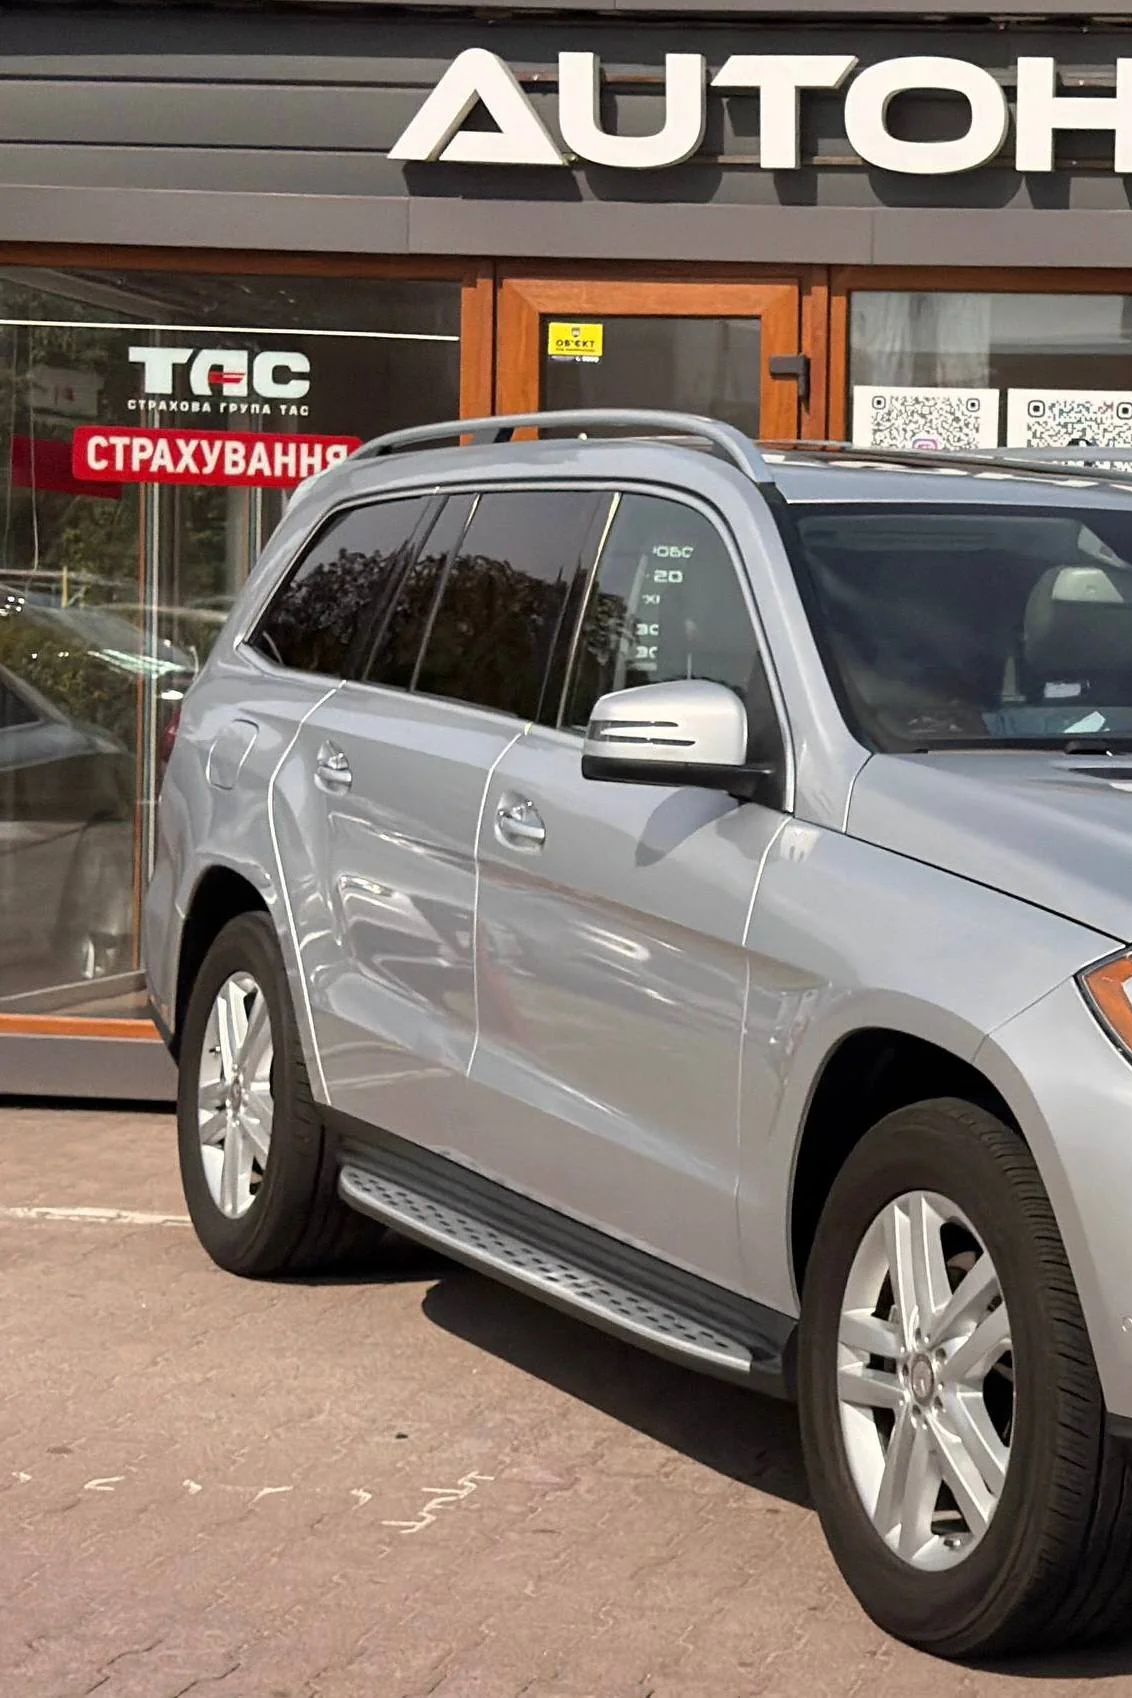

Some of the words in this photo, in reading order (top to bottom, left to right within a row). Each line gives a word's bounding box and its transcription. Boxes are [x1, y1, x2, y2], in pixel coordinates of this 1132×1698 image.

[127, 399, 211, 413] СТРАХОВА
[219, 402, 271, 415] ГРУПА
[280, 404, 309, 416] ТАС
[87, 435, 348, 478] СТРАХУВАННЯ
